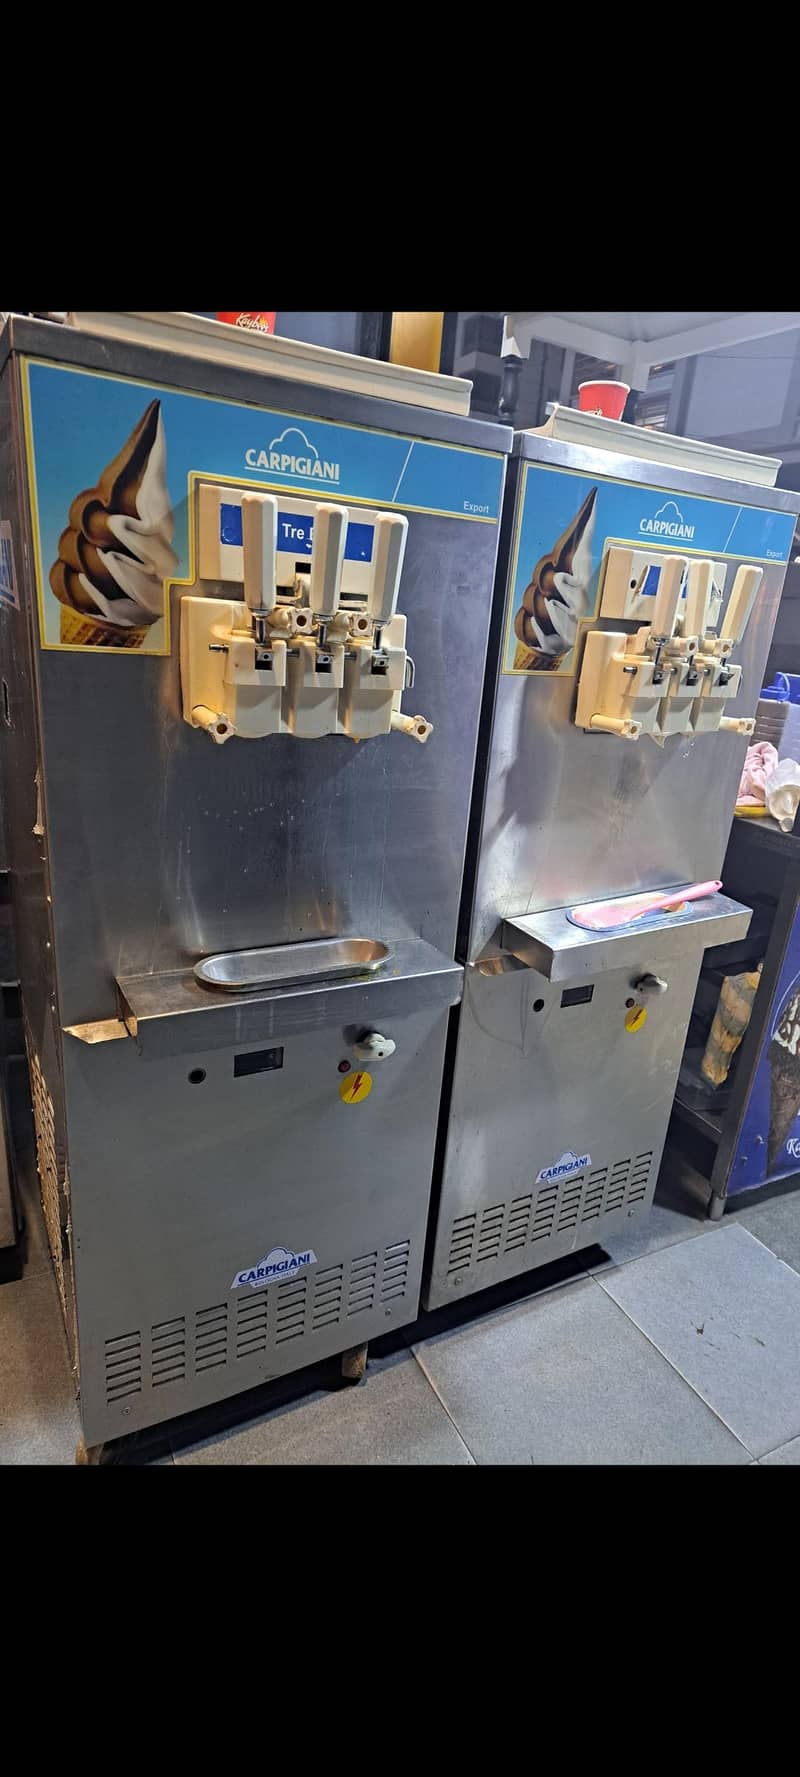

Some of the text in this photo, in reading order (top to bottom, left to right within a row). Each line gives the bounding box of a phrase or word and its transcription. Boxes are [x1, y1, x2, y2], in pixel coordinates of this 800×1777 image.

[245, 448, 340, 481] CARPIGIANI
[463, 500, 489, 513] Export
[281, 523, 304, 540] Tre
[640, 518, 695, 539] CARPIGIANI
[540, 1157, 588, 1179] CARPIGIANI
[238, 1253, 311, 1283] CARPIGIANI
